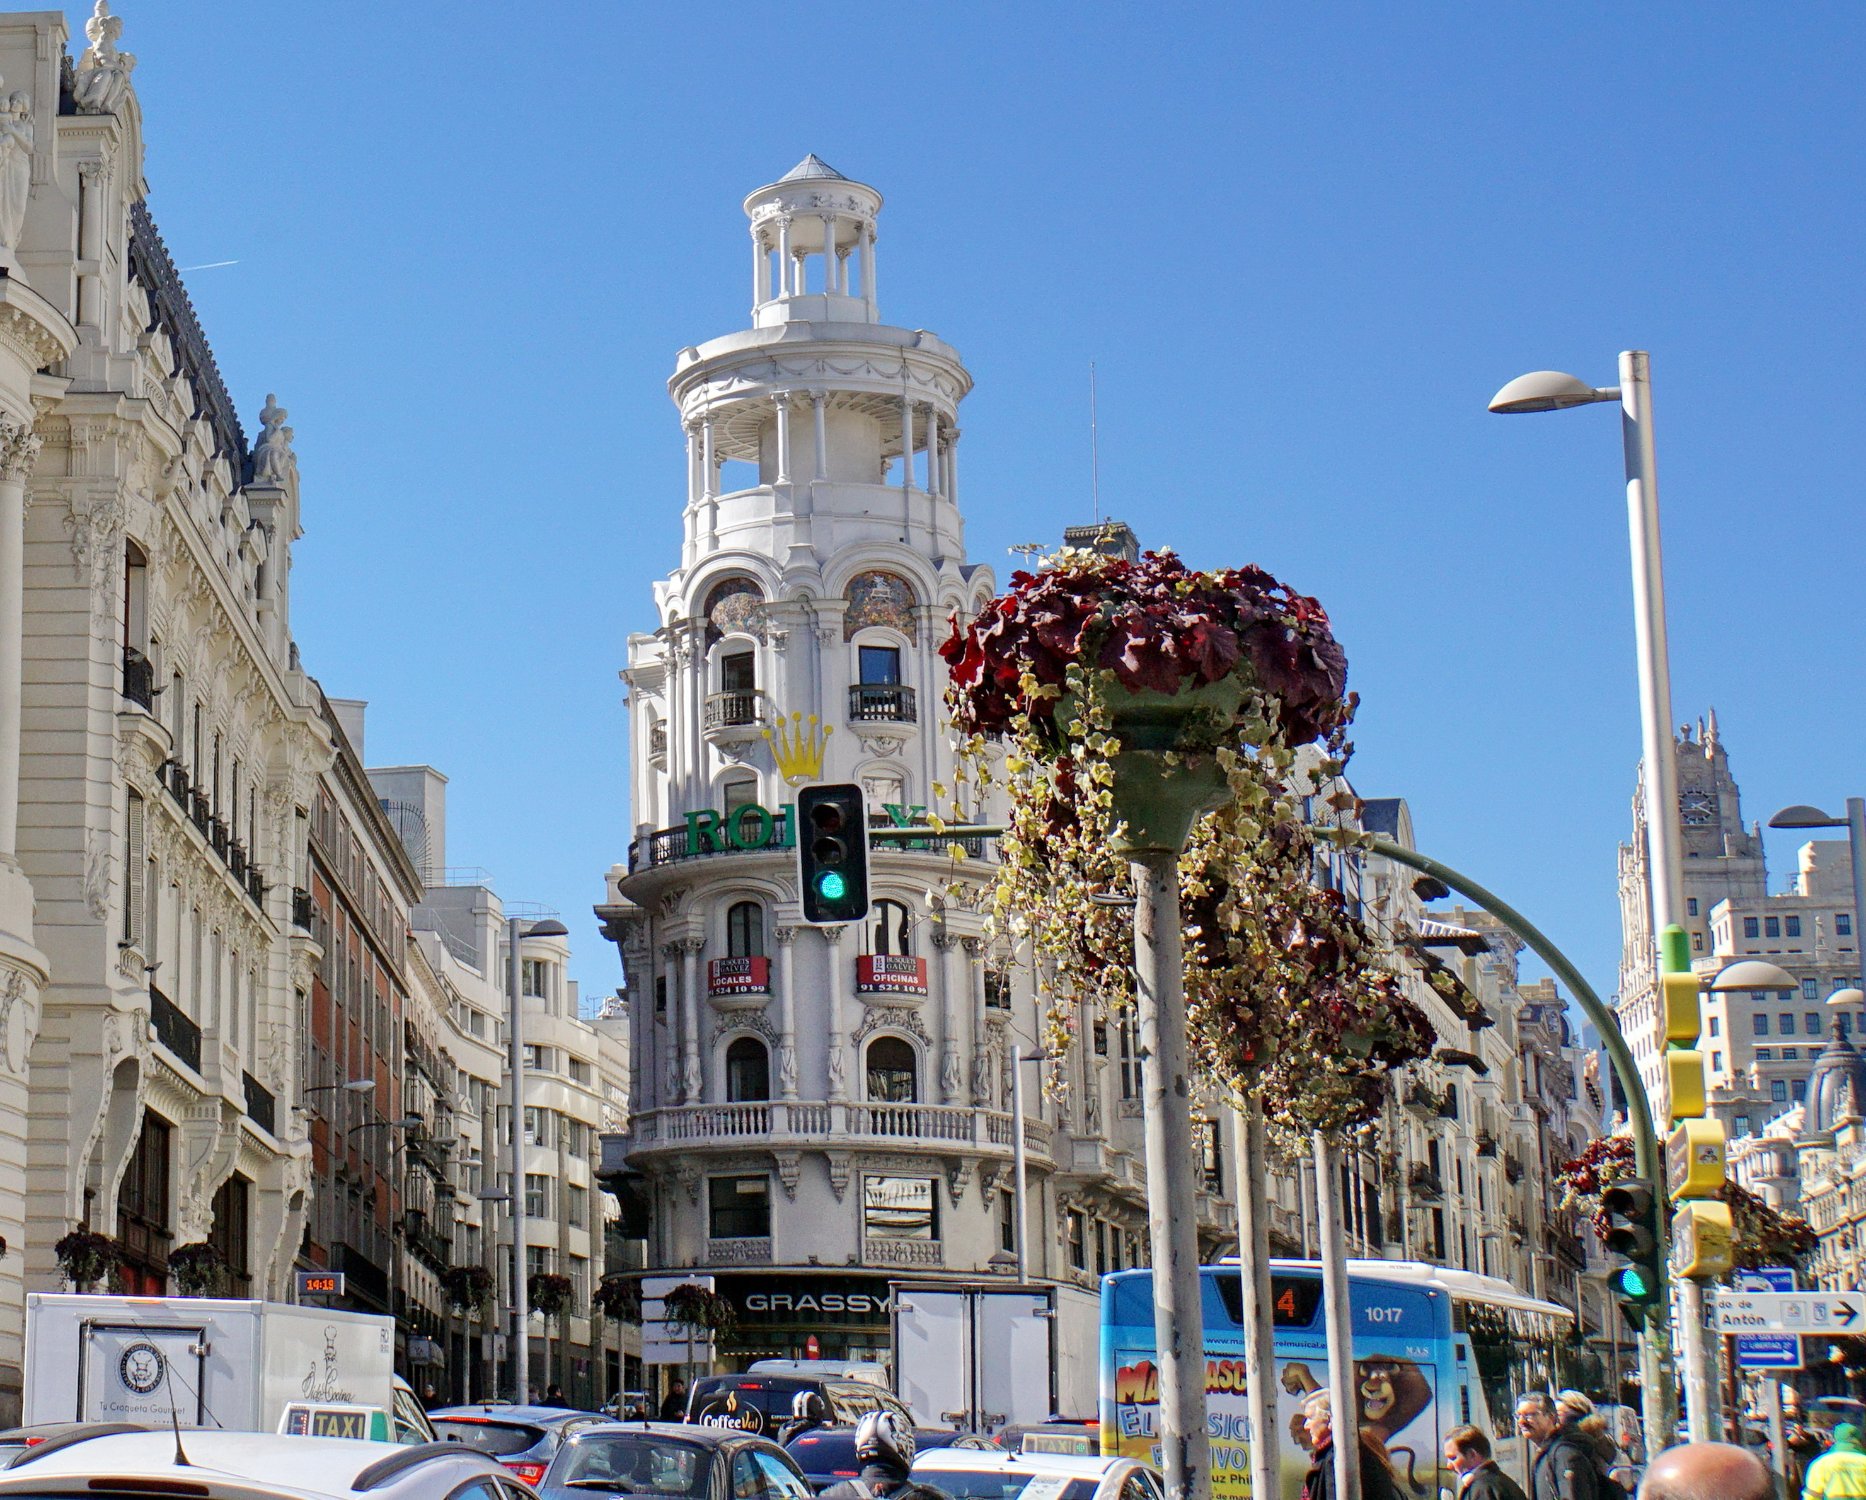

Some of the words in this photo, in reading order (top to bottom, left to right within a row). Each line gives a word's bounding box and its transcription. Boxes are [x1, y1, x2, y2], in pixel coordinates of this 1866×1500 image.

[887, 963, 916, 971] GALVEZ
[713, 976, 752, 987] LOCALES
[873, 974, 919, 984] OFICINAS
[716, 986, 731, 995] 524
[735, 985, 747, 993] 10
[751, 985, 765, 993] 99
[917, 986, 927, 994] 99
[746, 1294, 889, 1313] GRASSY
[1277, 1288, 1295, 1318] 4
[1738, 1301, 1752, 1309] de
[1365, 1307, 1402, 1322] 1017
[1722, 1313, 1766, 1326] Antón
[100, 1402, 108, 1411] Tu
[110, 1402, 148, 1413] Croqueta
[315, 1414, 364, 1439] TAXI
[1119, 1406, 1159, 1438] EL
